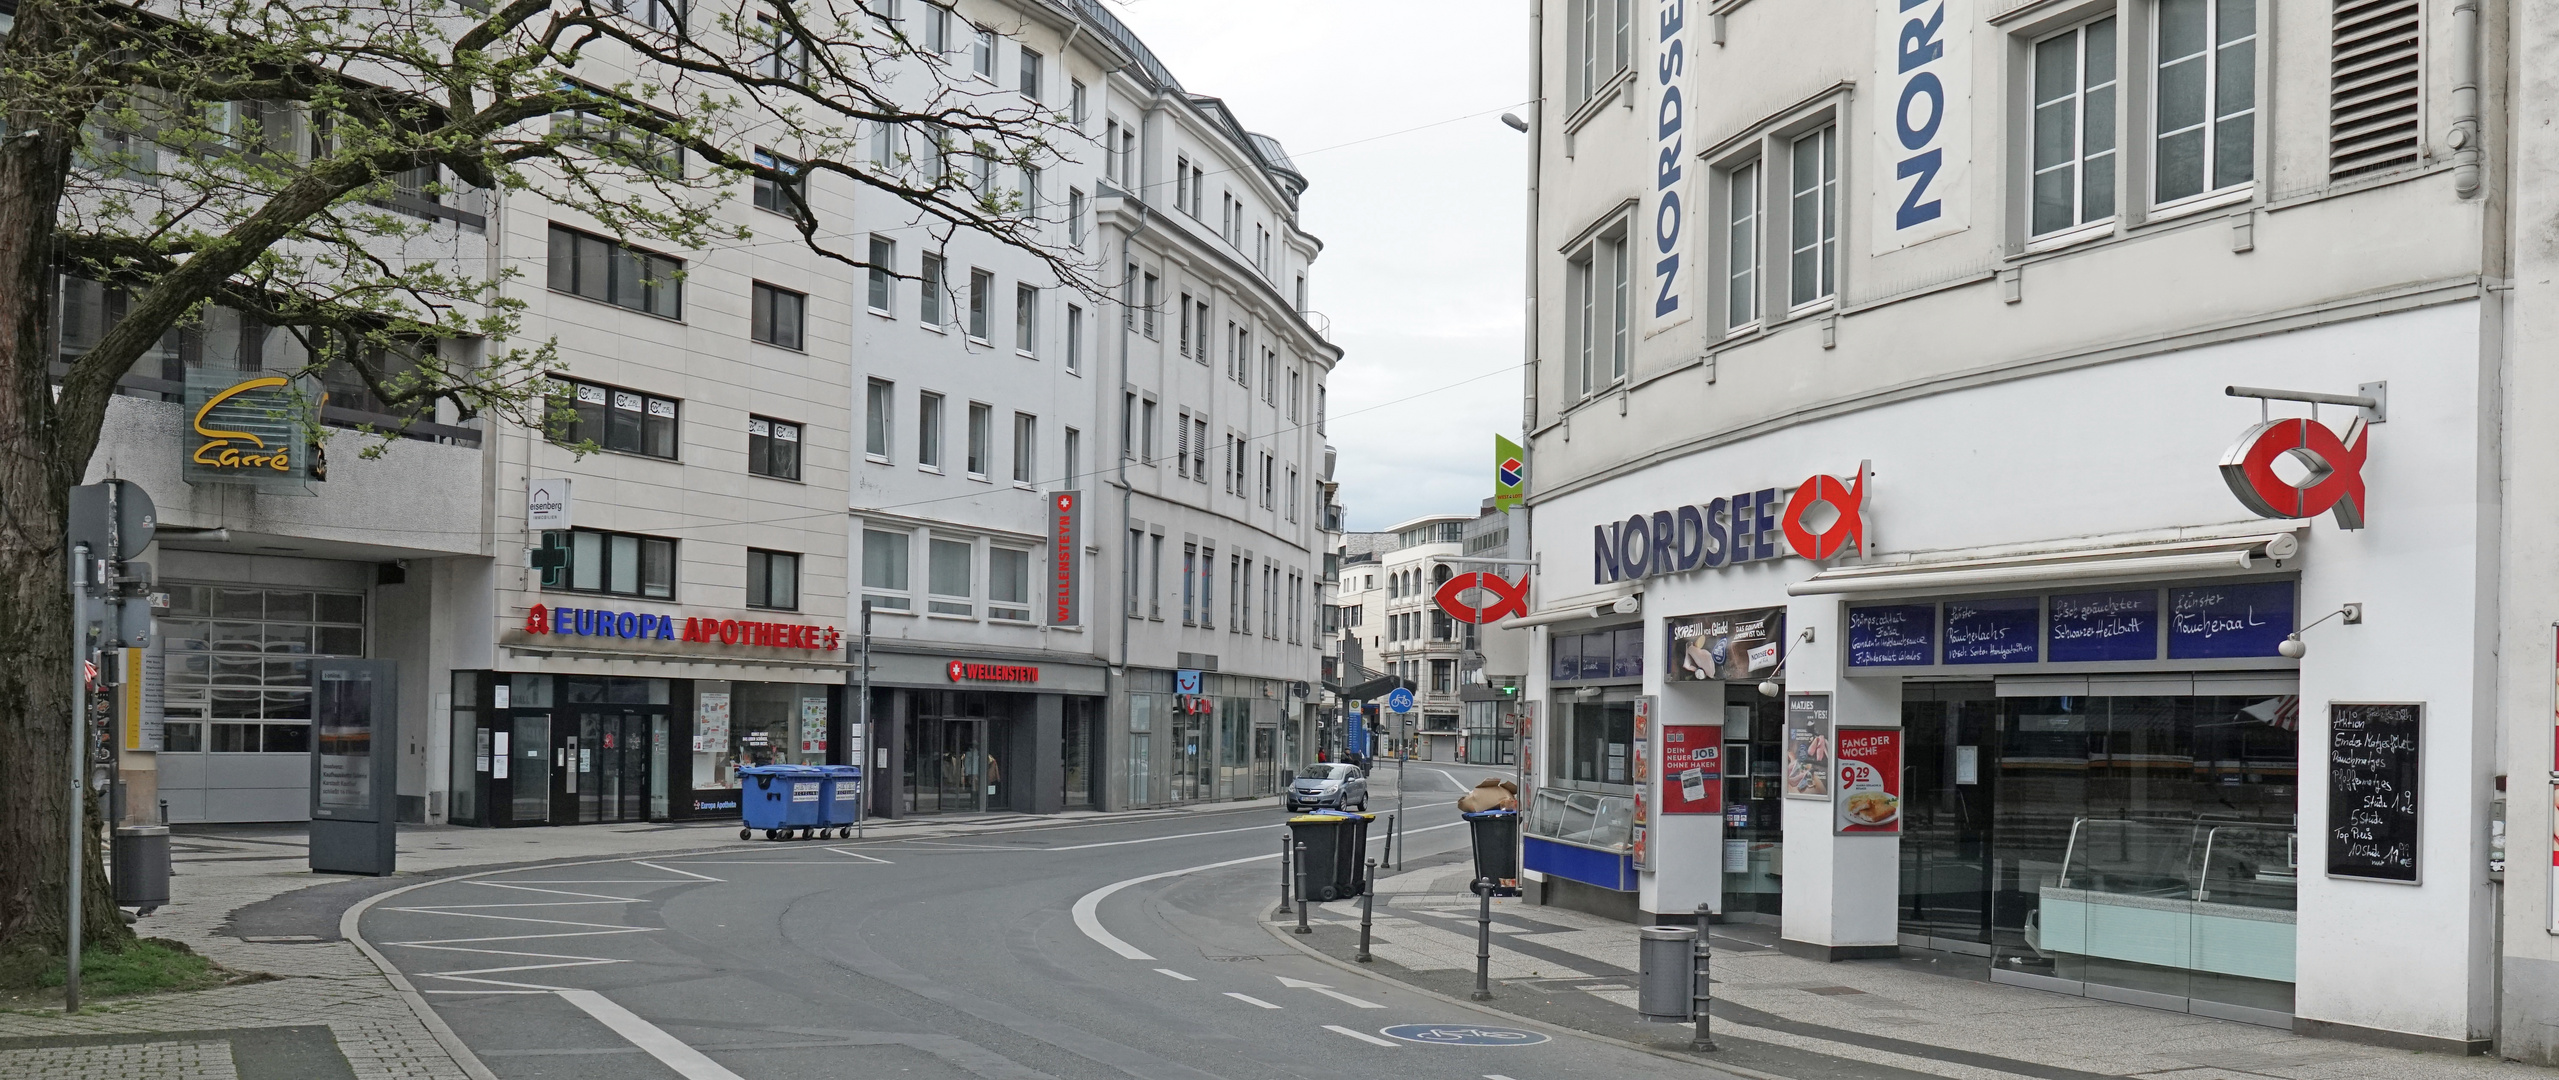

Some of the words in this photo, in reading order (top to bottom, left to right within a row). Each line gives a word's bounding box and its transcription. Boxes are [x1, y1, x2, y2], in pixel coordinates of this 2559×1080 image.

[1896, 0, 1944, 231] NOR
[1655, 0, 1684, 319] NORDSE
[193, 439, 290, 472] Carré
[530, 500, 562, 512] eisenberg
[1594, 487, 1783, 585] NORDSEE
[1057, 515, 1071, 622] WELLENSTEYN
[554, 606, 676, 641] EUROPA
[682, 616, 821, 650] APOTHEKE
[2096, 617, 2144, 639] Heilbutt
[966, 663, 1039, 683] WELLENSTEYN
[1790, 701, 1814, 710] MATJES
[1841, 738, 1868, 748] FANG
[1870, 736, 1890, 746] DER
[1842, 747, 1878, 757] WOCHE
[1694, 748, 1715, 759] JOB
[701, 801, 716, 811] Europa
[716, 801, 737, 810] Apotheke
[2334, 826, 2349, 844] Top
